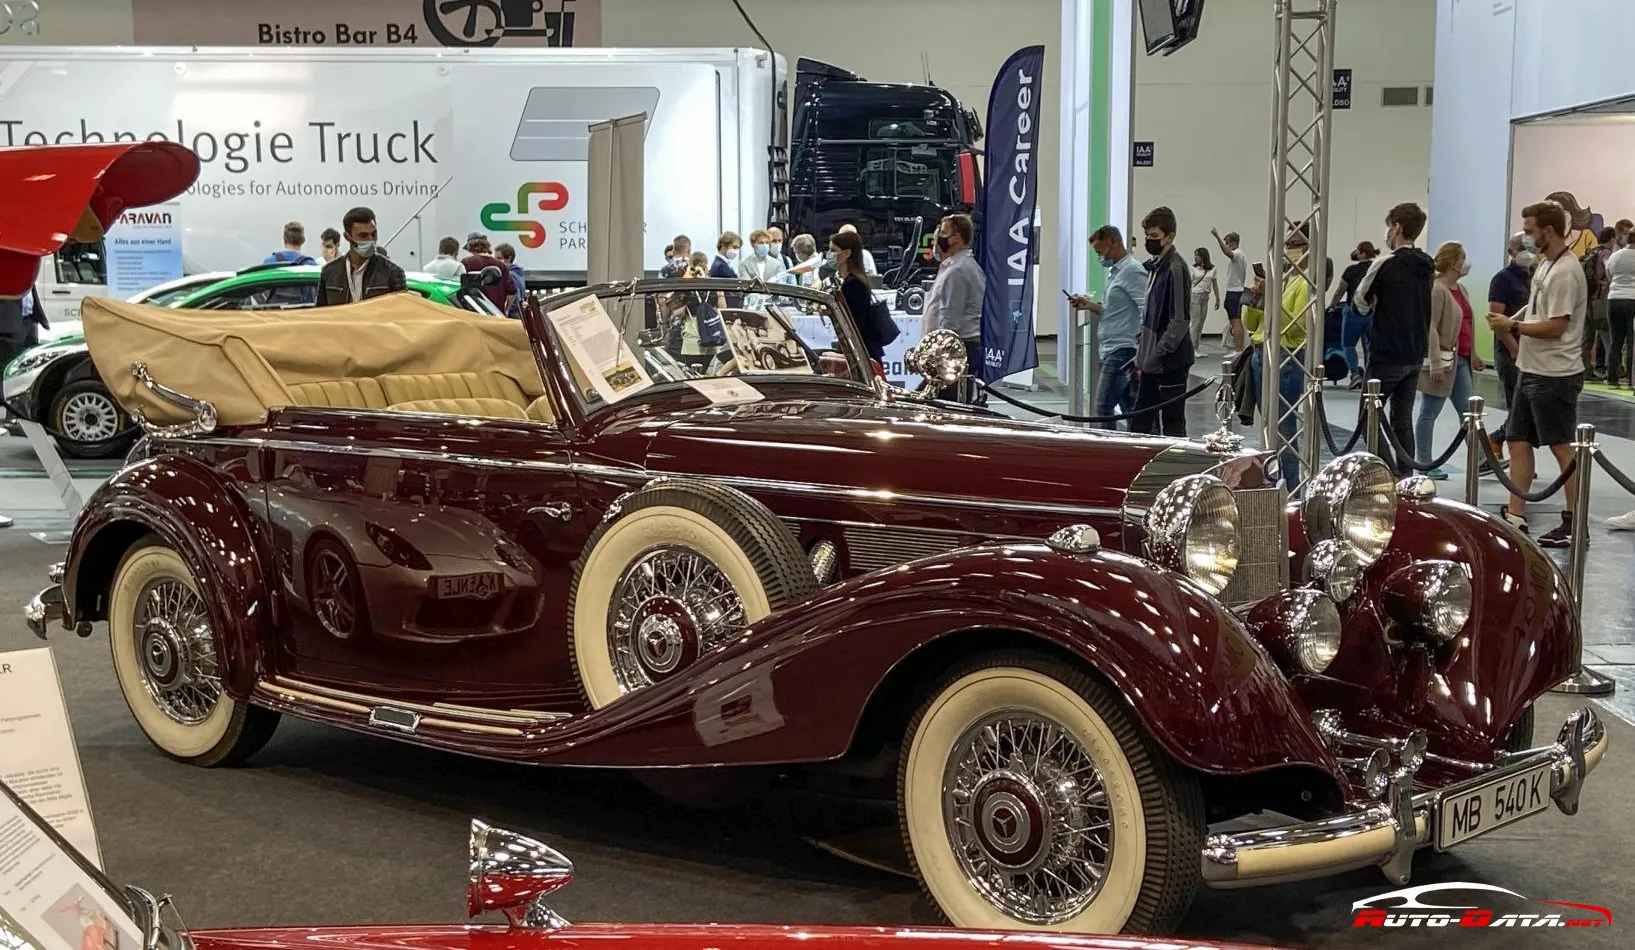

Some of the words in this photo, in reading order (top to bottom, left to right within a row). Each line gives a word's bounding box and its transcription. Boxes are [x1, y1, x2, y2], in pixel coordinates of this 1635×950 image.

[258, 23, 326, 44] Bistro
[335, 23, 377, 44] Bar
[386, 23, 418, 44] B4
[308, 120, 438, 164] Truck
[1008, 68, 1033, 205] Career
[187, 180, 245, 198] ologies
[249, 180, 271, 196] for
[276, 180, 378, 196] Autonomous
[383, 180, 439, 198] Driving
[120, 213, 172, 224] ARAVAN
[1007, 216, 1030, 286] IAA
[1452, 795, 1482, 838] MB
